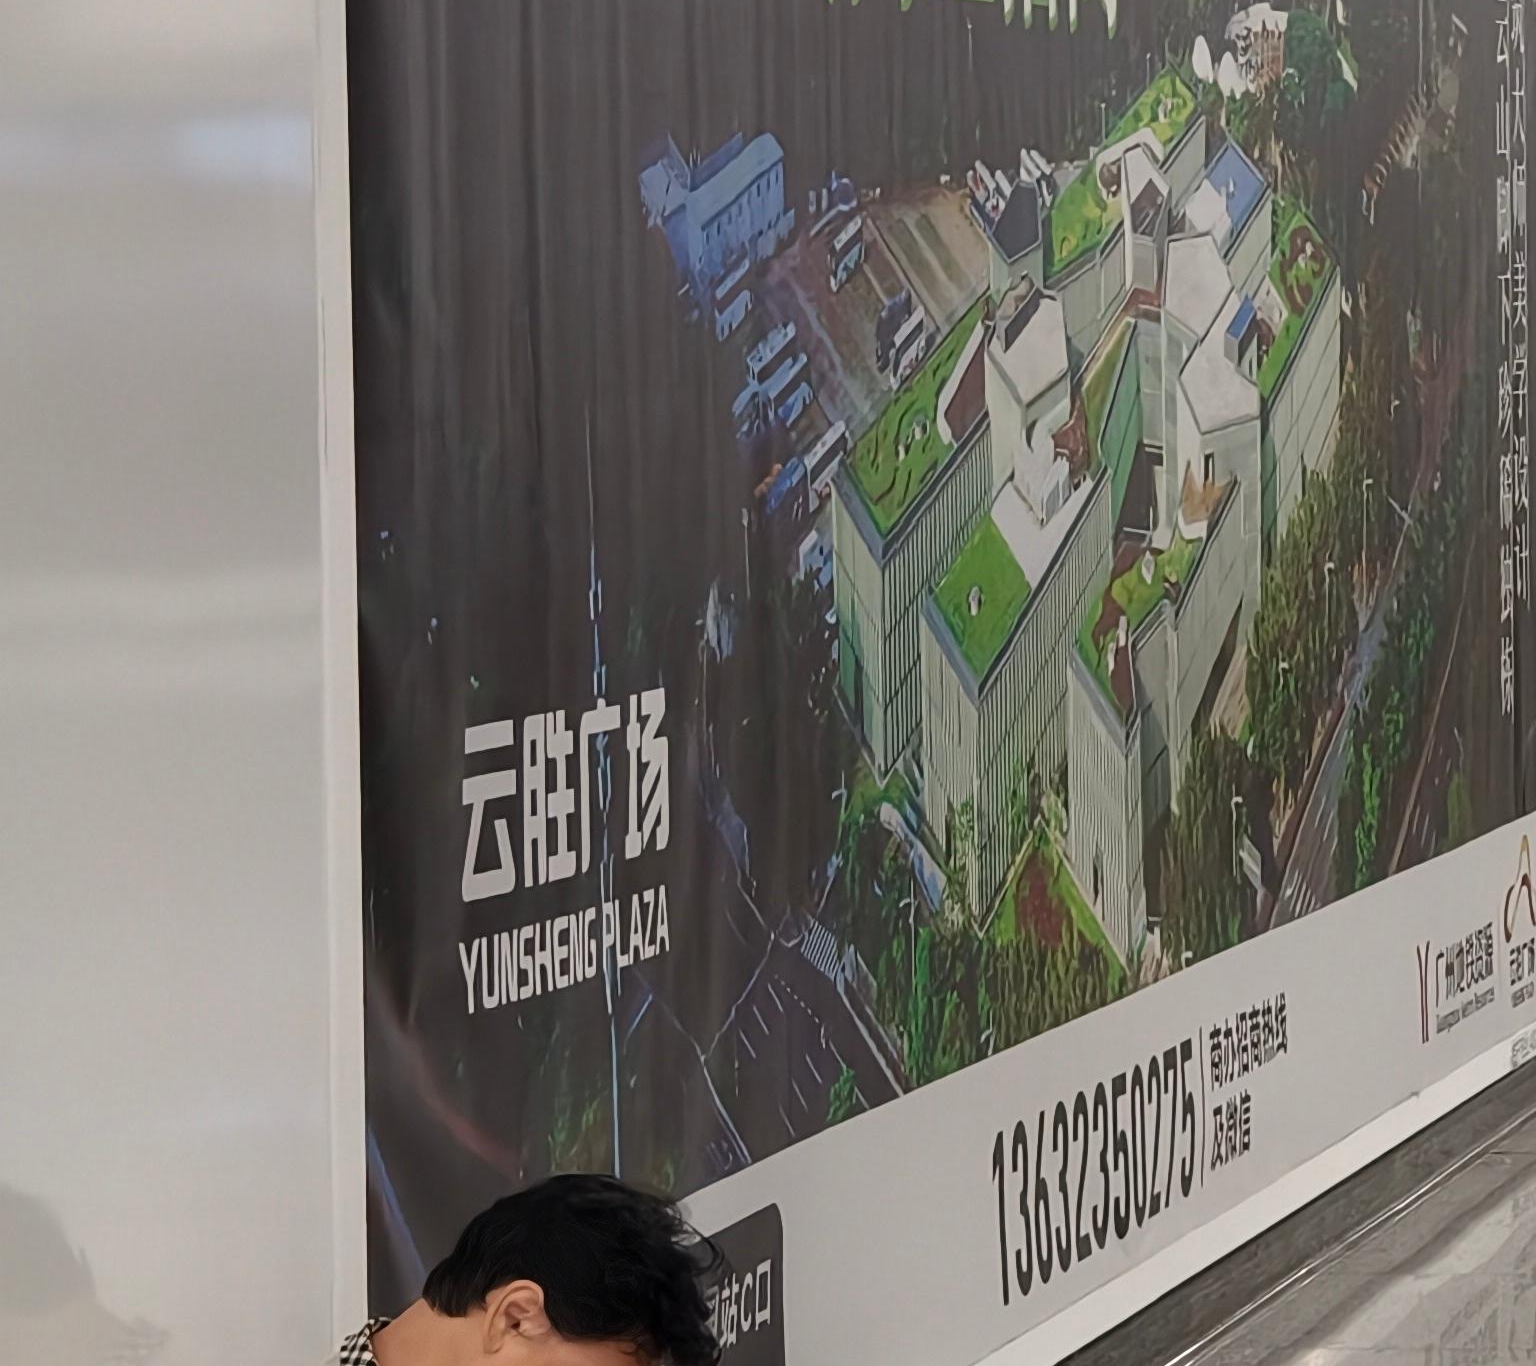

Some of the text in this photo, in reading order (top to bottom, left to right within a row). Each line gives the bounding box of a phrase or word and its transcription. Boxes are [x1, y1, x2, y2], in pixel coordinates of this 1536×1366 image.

[462, 687, 670, 903] 云胜广场
[458, 884, 670, 1015] YUNSHENG PLAZA
[992, 1037, 1197, 1307] 13632350275
[1210, 1088, 1252, 1172] 及微信
